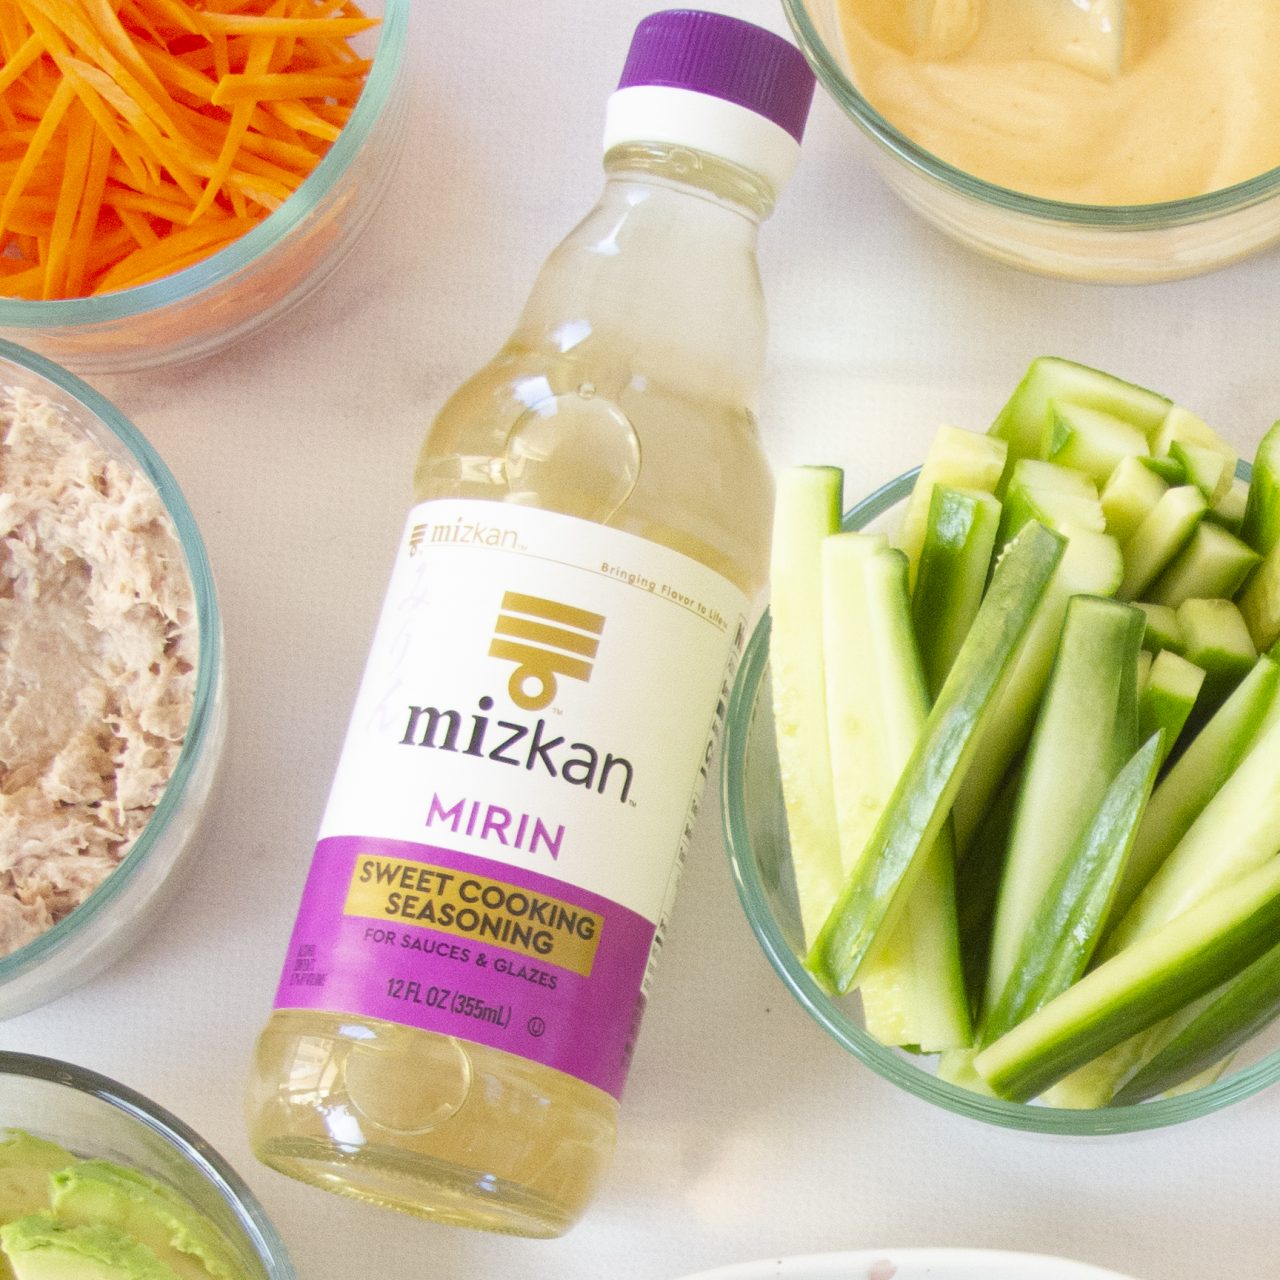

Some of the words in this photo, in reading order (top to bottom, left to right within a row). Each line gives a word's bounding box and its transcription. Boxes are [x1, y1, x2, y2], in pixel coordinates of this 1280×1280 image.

[431, 517, 518, 550] mizkan
[601, 562, 656, 592] Bringing
[661, 584, 695, 607] Flavor
[697, 602, 707, 615] to
[398, 695, 634, 804] mizkan
[425, 791, 566, 861] MIRIN
[359, 860, 455, 896] SWEET
[459, 879, 596, 941] COOKING
[384, 892, 554, 955] SEASONING
[364, 928, 395, 945] FOR
[400, 934, 472, 963] SAUCES
[475, 953, 488, 968] &
[493, 958, 559, 990] GLAZES
[387, 978, 405, 998] 12
[404, 981, 422, 1004] FL
[425, 986, 451, 1011] OZ
[450, 990, 512, 1029] (355mL)
